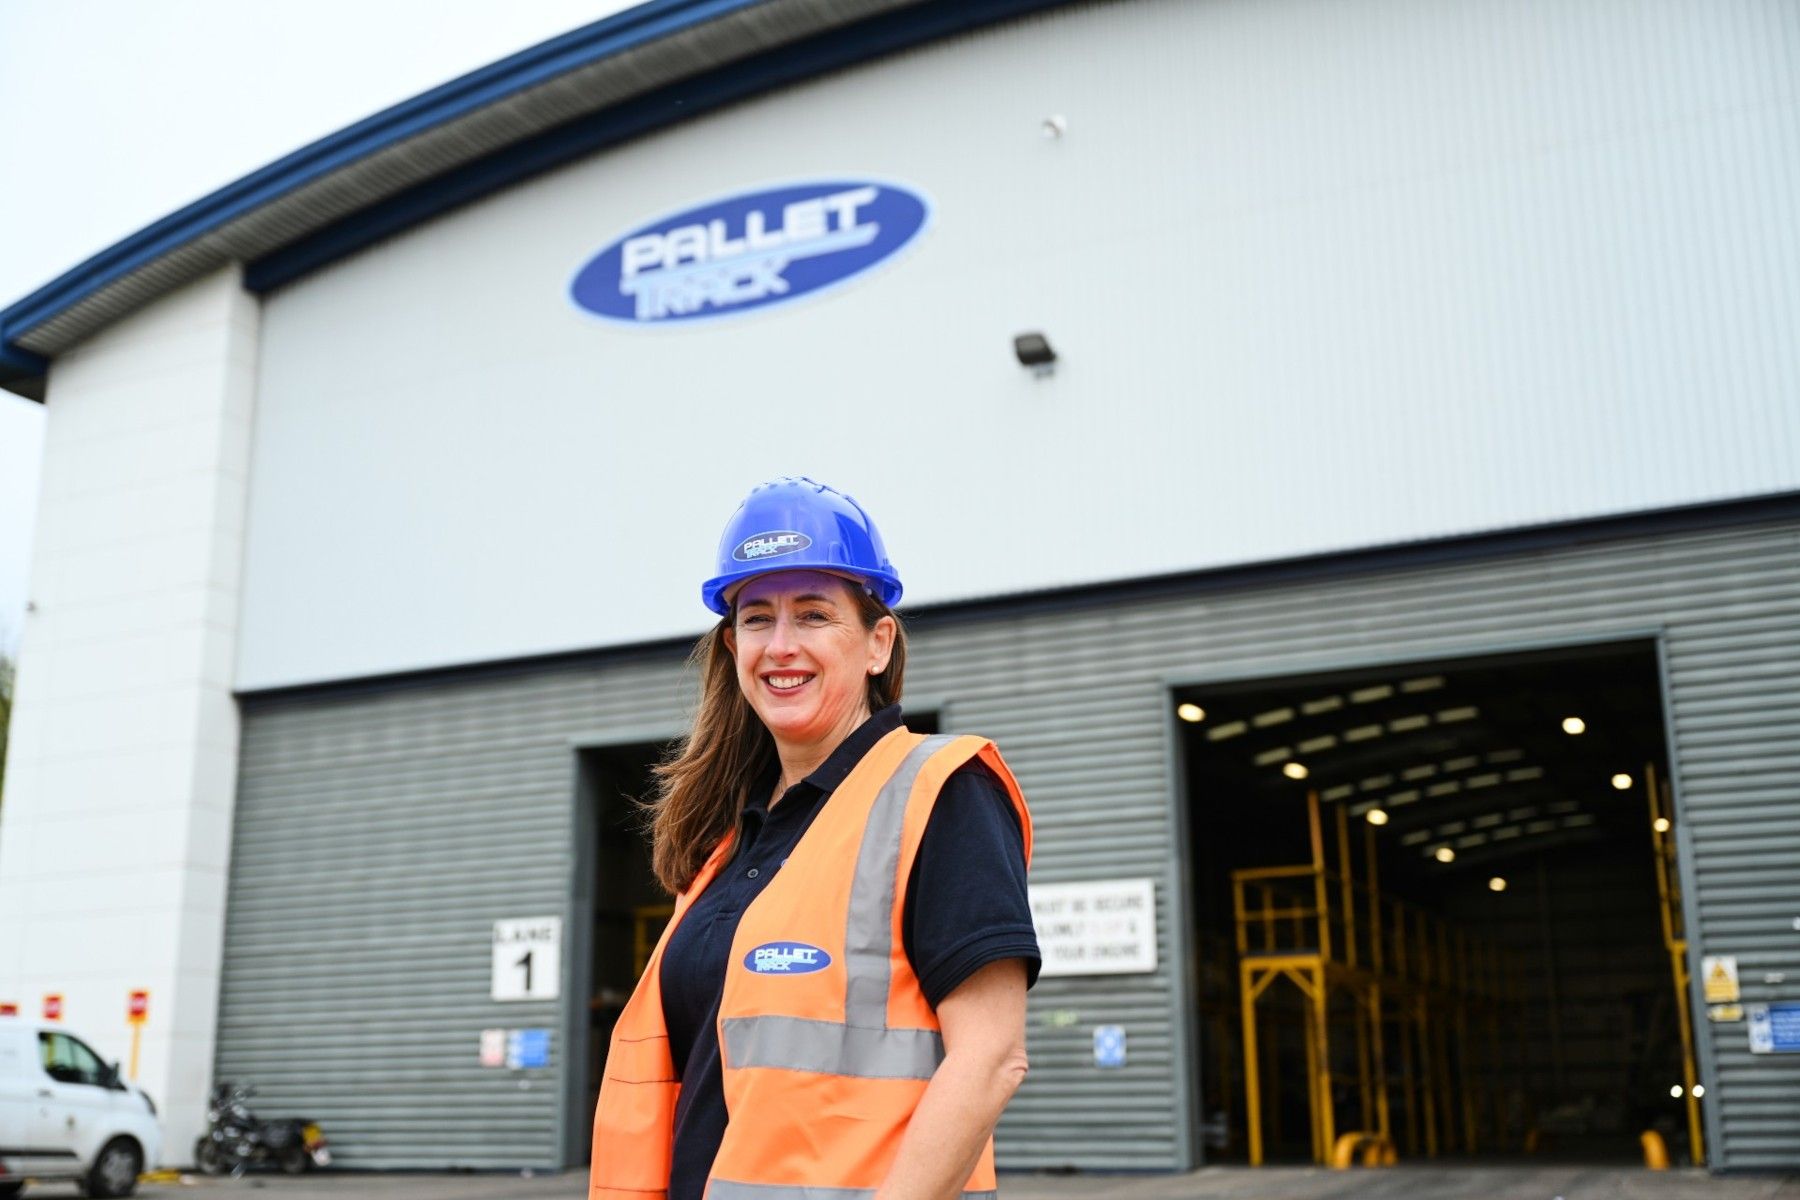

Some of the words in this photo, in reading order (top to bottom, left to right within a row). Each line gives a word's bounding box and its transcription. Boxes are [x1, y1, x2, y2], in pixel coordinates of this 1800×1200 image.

[620, 186, 879, 277] PALLET
[619, 248, 796, 322] TRACK
[743, 534, 799, 553] PALLET
[513, 950, 533, 991] 1
[754, 947, 819, 961] PALLET
